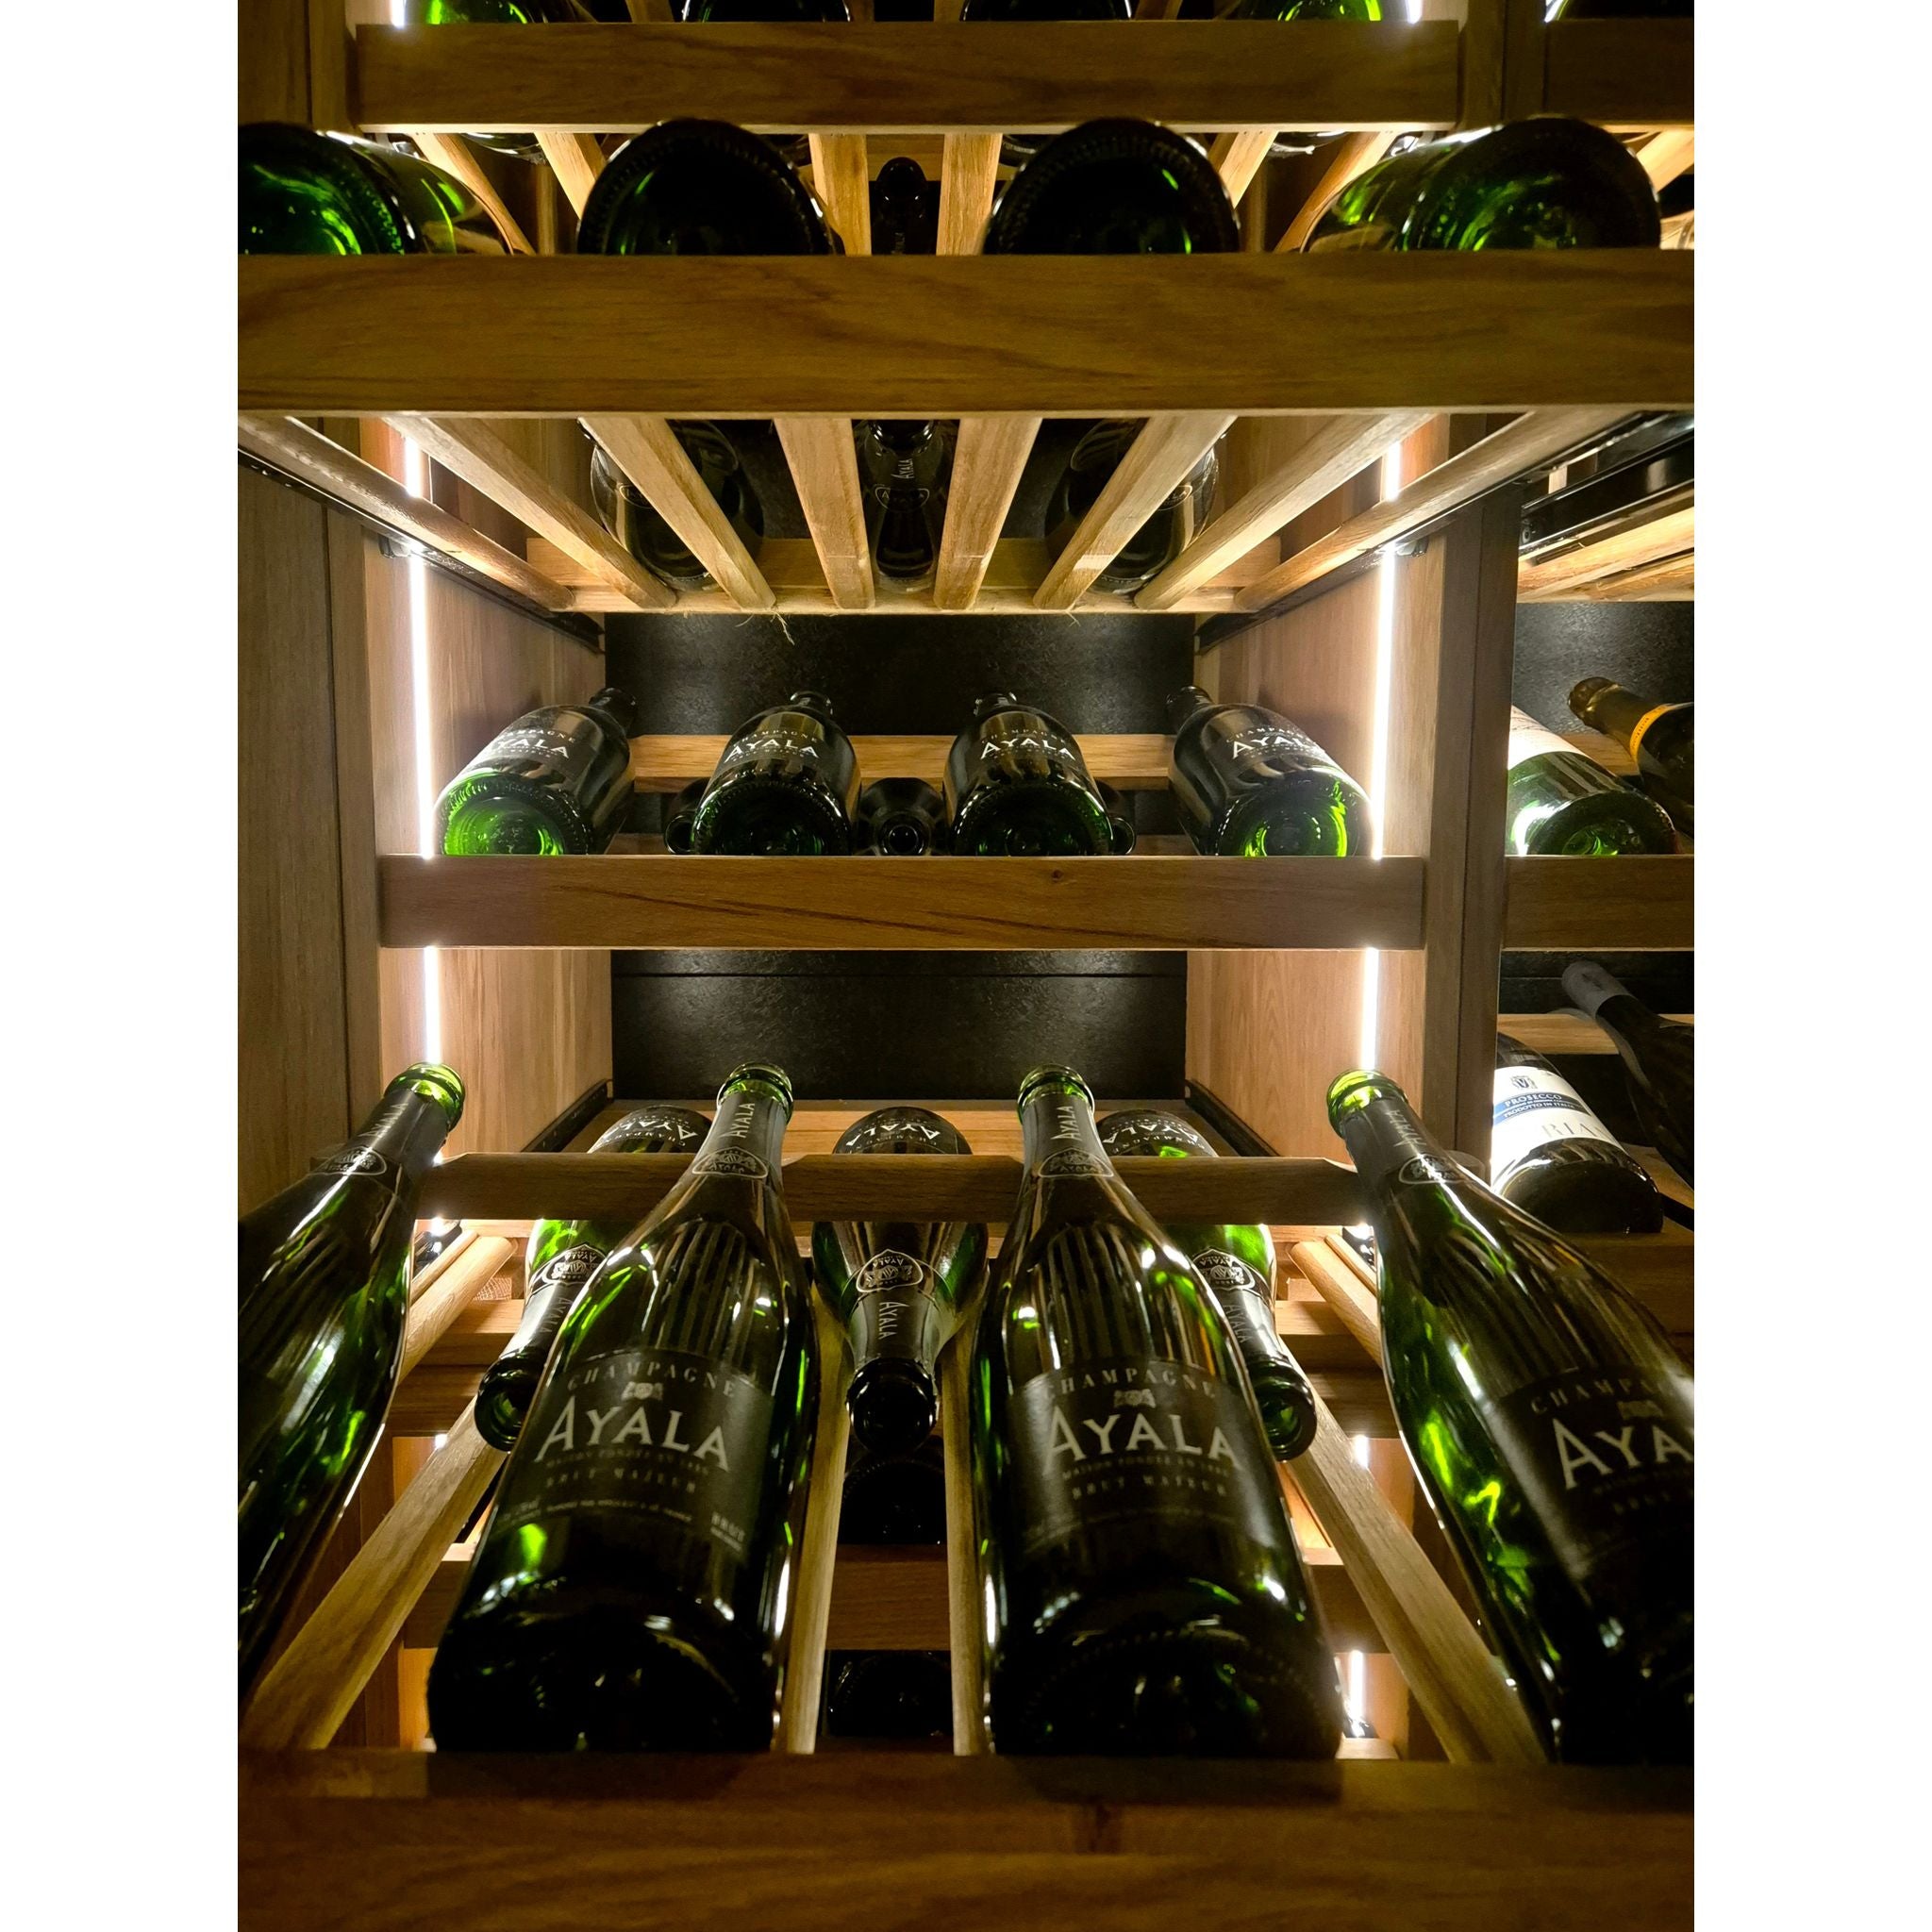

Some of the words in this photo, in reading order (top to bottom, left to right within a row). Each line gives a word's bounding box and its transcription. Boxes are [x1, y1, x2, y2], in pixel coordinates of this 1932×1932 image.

[724, 739, 819, 763] AYALA
[981, 738, 1075, 759] AYALA
[1505, 1093, 1562, 1108] PROSECCO
[718, 1103, 756, 1139] AYALA
[846, 1124, 941, 1146] AYALA
[1050, 1106, 1083, 1141] AYALA
[878, 1302, 910, 1340] AYALA
[568, 1361, 735, 1398] CHAMPAGNE
[535, 1395, 730, 1473] AYALA
[1041, 1406, 1244, 1477] AYALA
